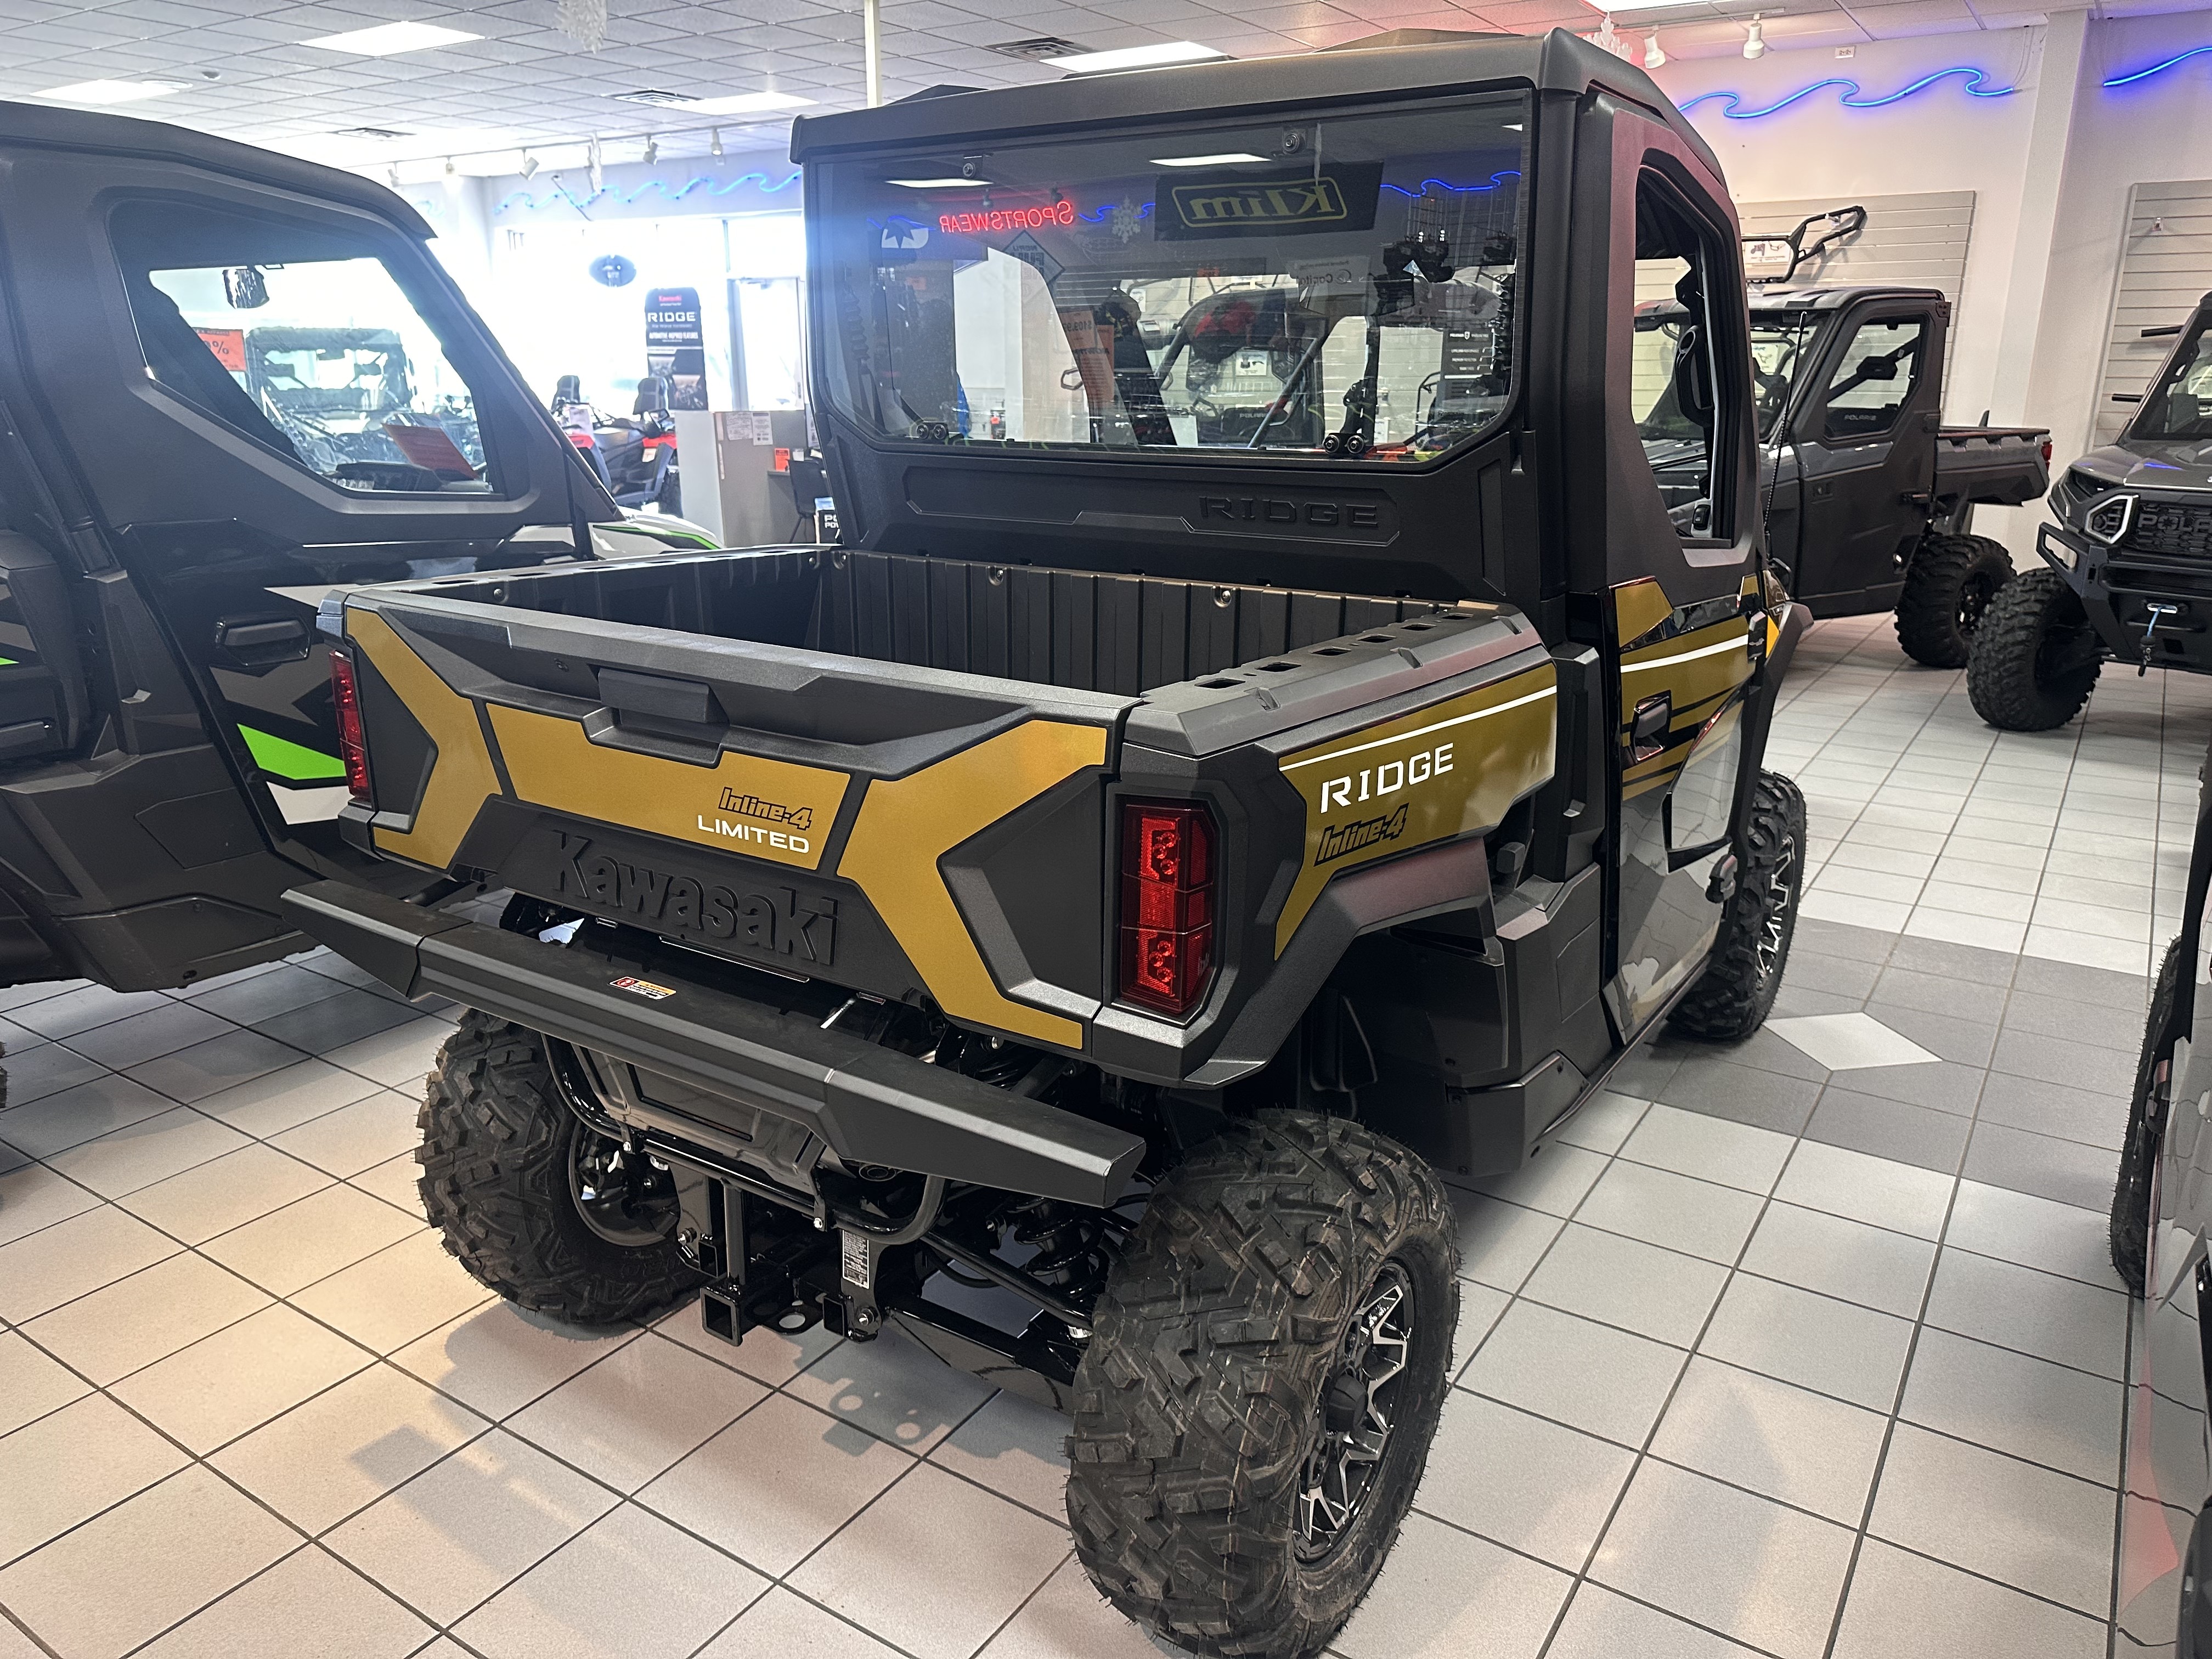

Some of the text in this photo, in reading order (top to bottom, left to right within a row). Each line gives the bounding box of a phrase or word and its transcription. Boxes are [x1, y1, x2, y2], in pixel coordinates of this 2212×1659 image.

[647, 311, 696, 323] RIDGE
[1199, 495, 1379, 528] RIDGE
[1320, 742, 1454, 814] RIDGE
[718, 787, 813, 831] Inline-4
[697, 814, 810, 854] LIMITED
[1314, 803, 1410, 866] Inline-4
[550, 830, 839, 966] Kawasaki
